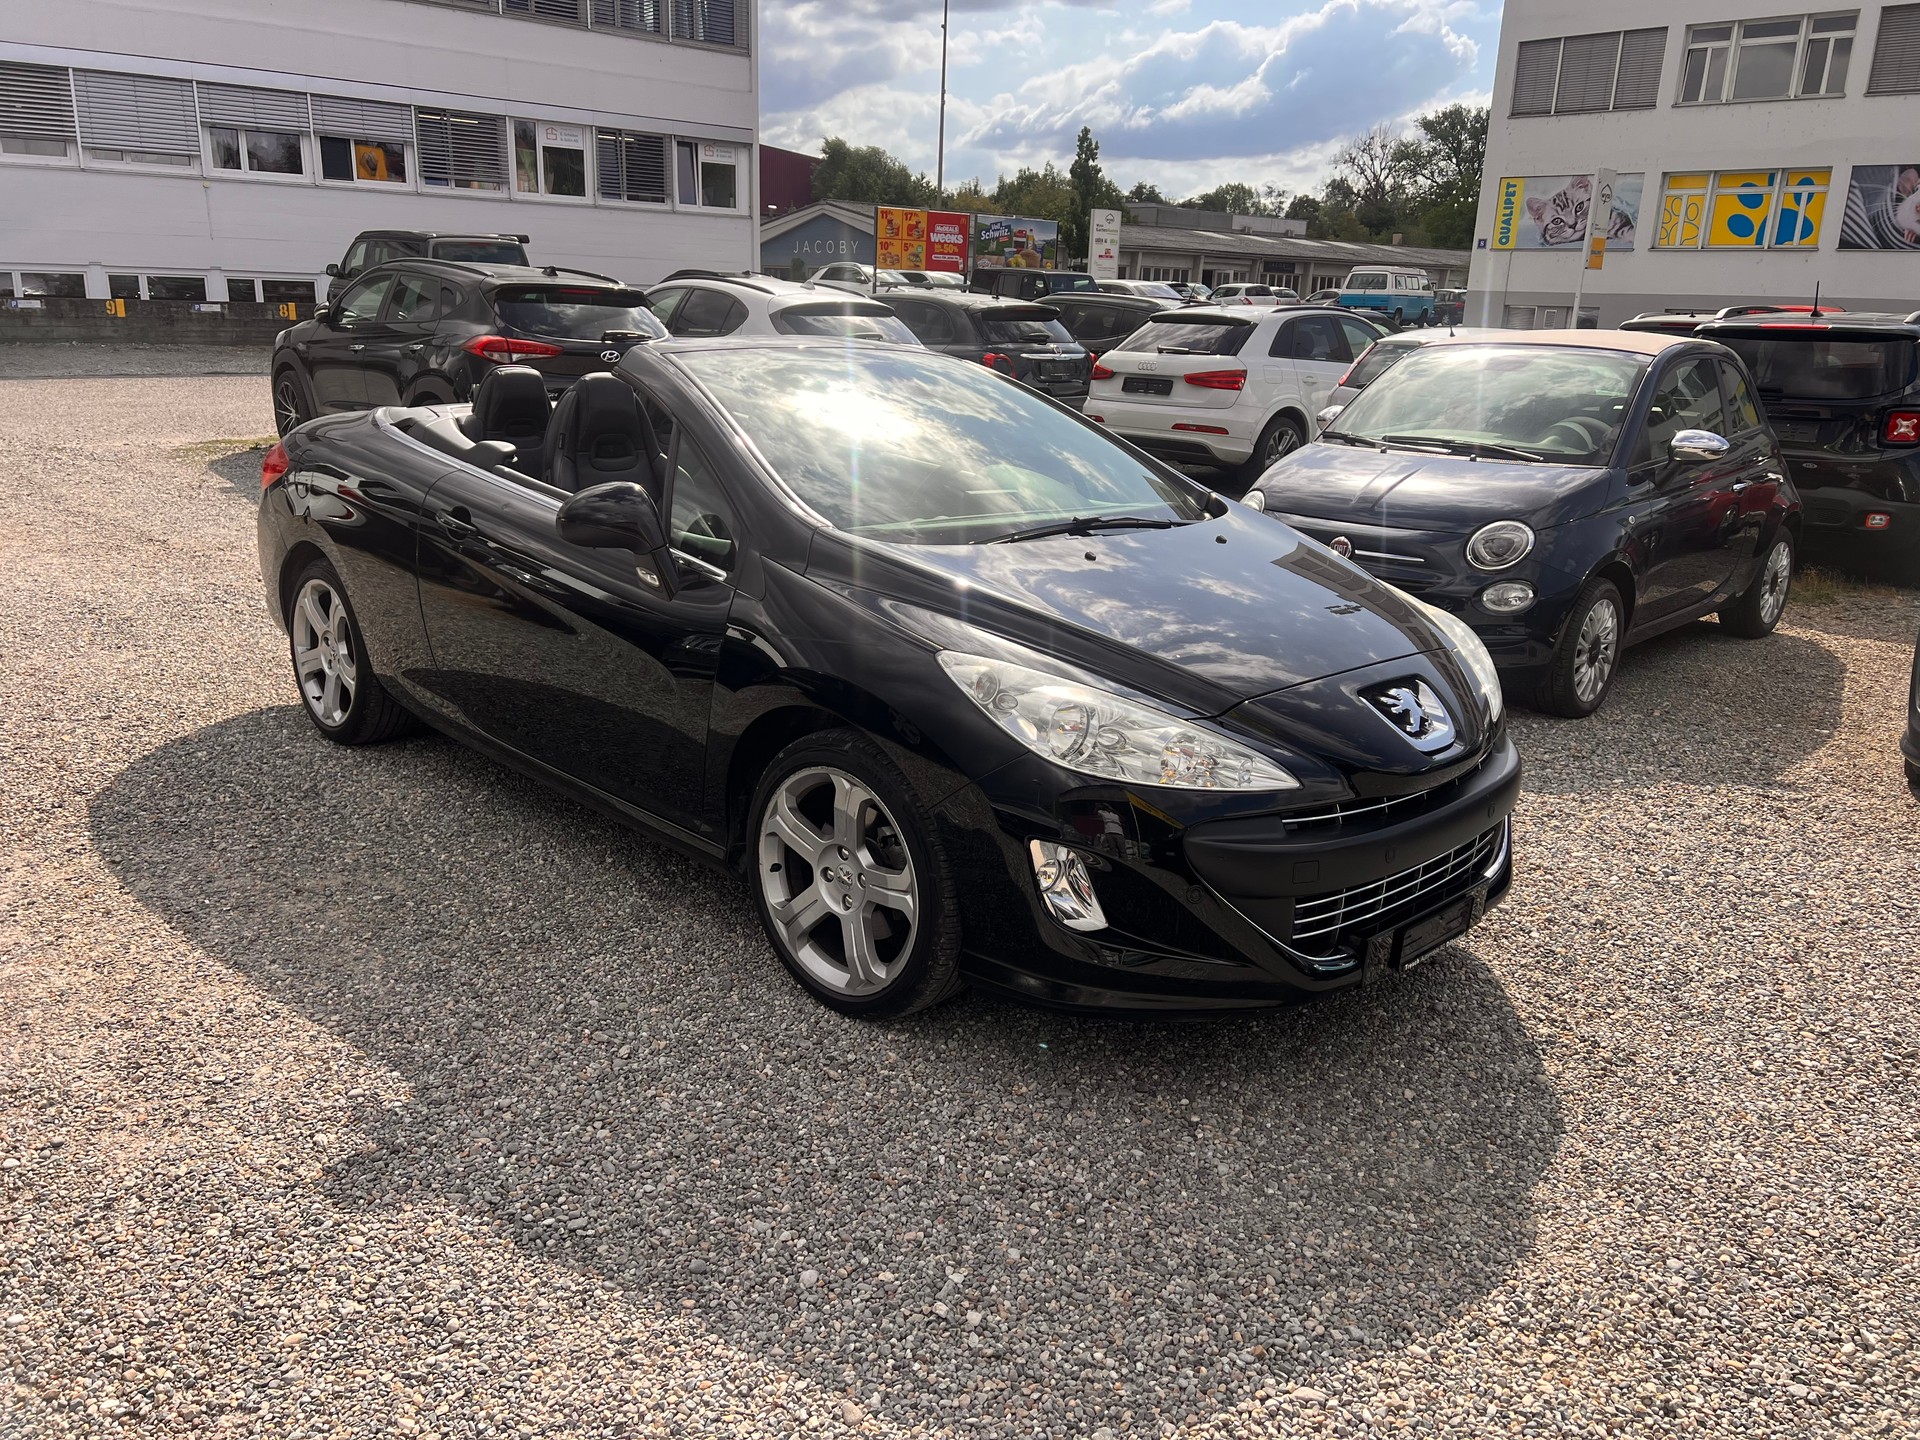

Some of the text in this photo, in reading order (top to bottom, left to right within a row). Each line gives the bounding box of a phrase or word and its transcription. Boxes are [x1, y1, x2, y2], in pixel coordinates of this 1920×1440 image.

[904, 211, 913, 221] 17
[1498, 182, 1518, 246] QUALIPET
[793, 240, 859, 254] JACOBY
[880, 240, 889, 251] 10
[903, 242, 909, 251] 5
[105, 300, 116, 315] 9
[278, 304, 289, 318] 8
